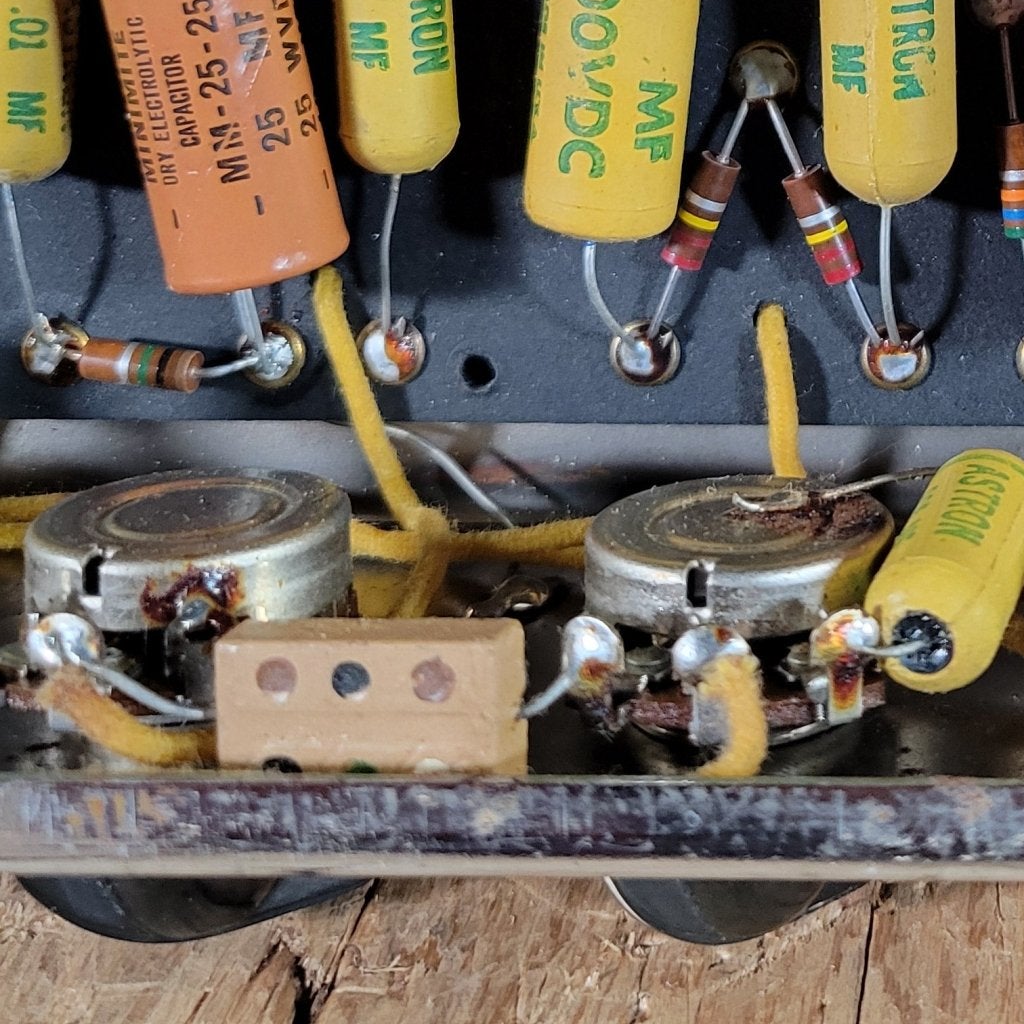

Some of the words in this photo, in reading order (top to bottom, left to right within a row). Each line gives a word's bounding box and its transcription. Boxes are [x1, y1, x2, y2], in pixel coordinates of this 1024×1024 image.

[233, 11, 272, 63] MF
[349, 22, 390, 71] MF
[127, 16, 170, 141] ELECTROLYTIC
[831, 43, 867, 96] MF
[7, 91, 47, 134] MF
[161, 54, 201, 147] CAPACITOR
[295, 94, 318, 137] 25
[633, 80, 678, 164] MF
[255, 106, 291, 152] 25
[157, 152, 178, 185] DRY
[934, 463, 1010, 546] ASTRON
